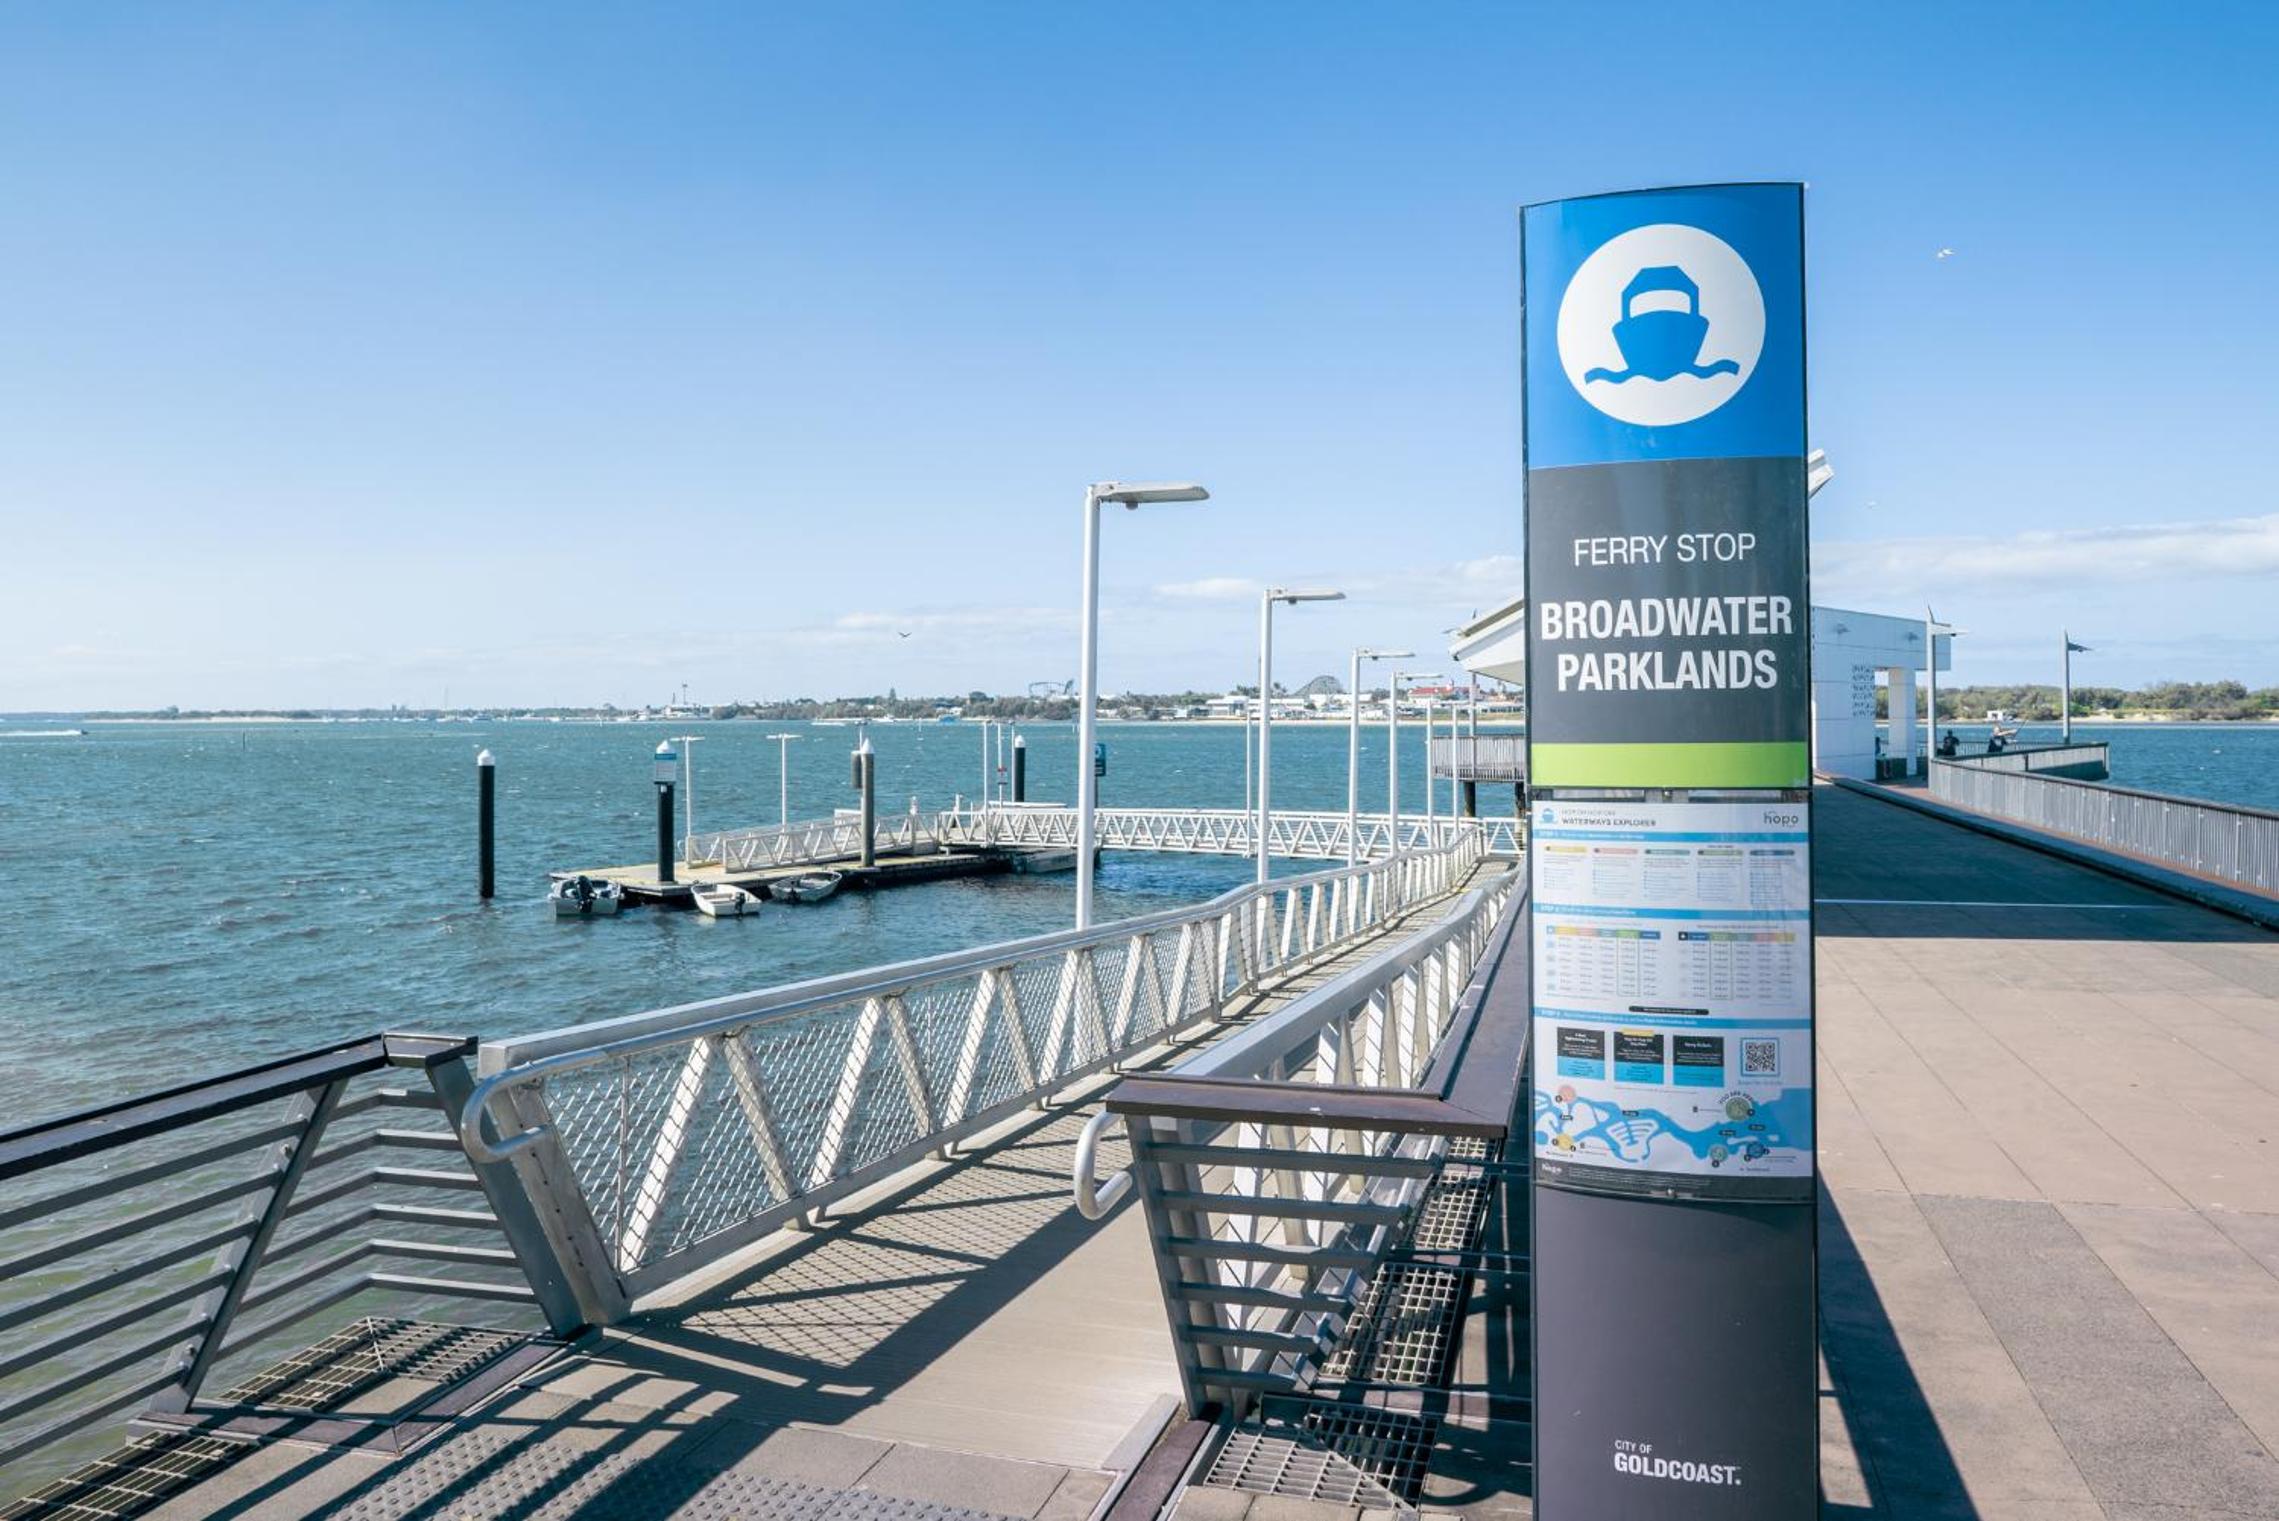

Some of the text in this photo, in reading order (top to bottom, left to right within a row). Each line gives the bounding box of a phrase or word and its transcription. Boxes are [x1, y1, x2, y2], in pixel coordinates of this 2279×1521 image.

[1574, 533, 1756, 567] FERRY STOP
[1541, 596, 1793, 640] BROADWATER
[1557, 649, 1778, 692] PARKLANDS
[1562, 817, 1611, 826] WATERWAYS
[1763, 811, 1799, 827] hopo
[1614, 1439, 1652, 1454] CITY OF
